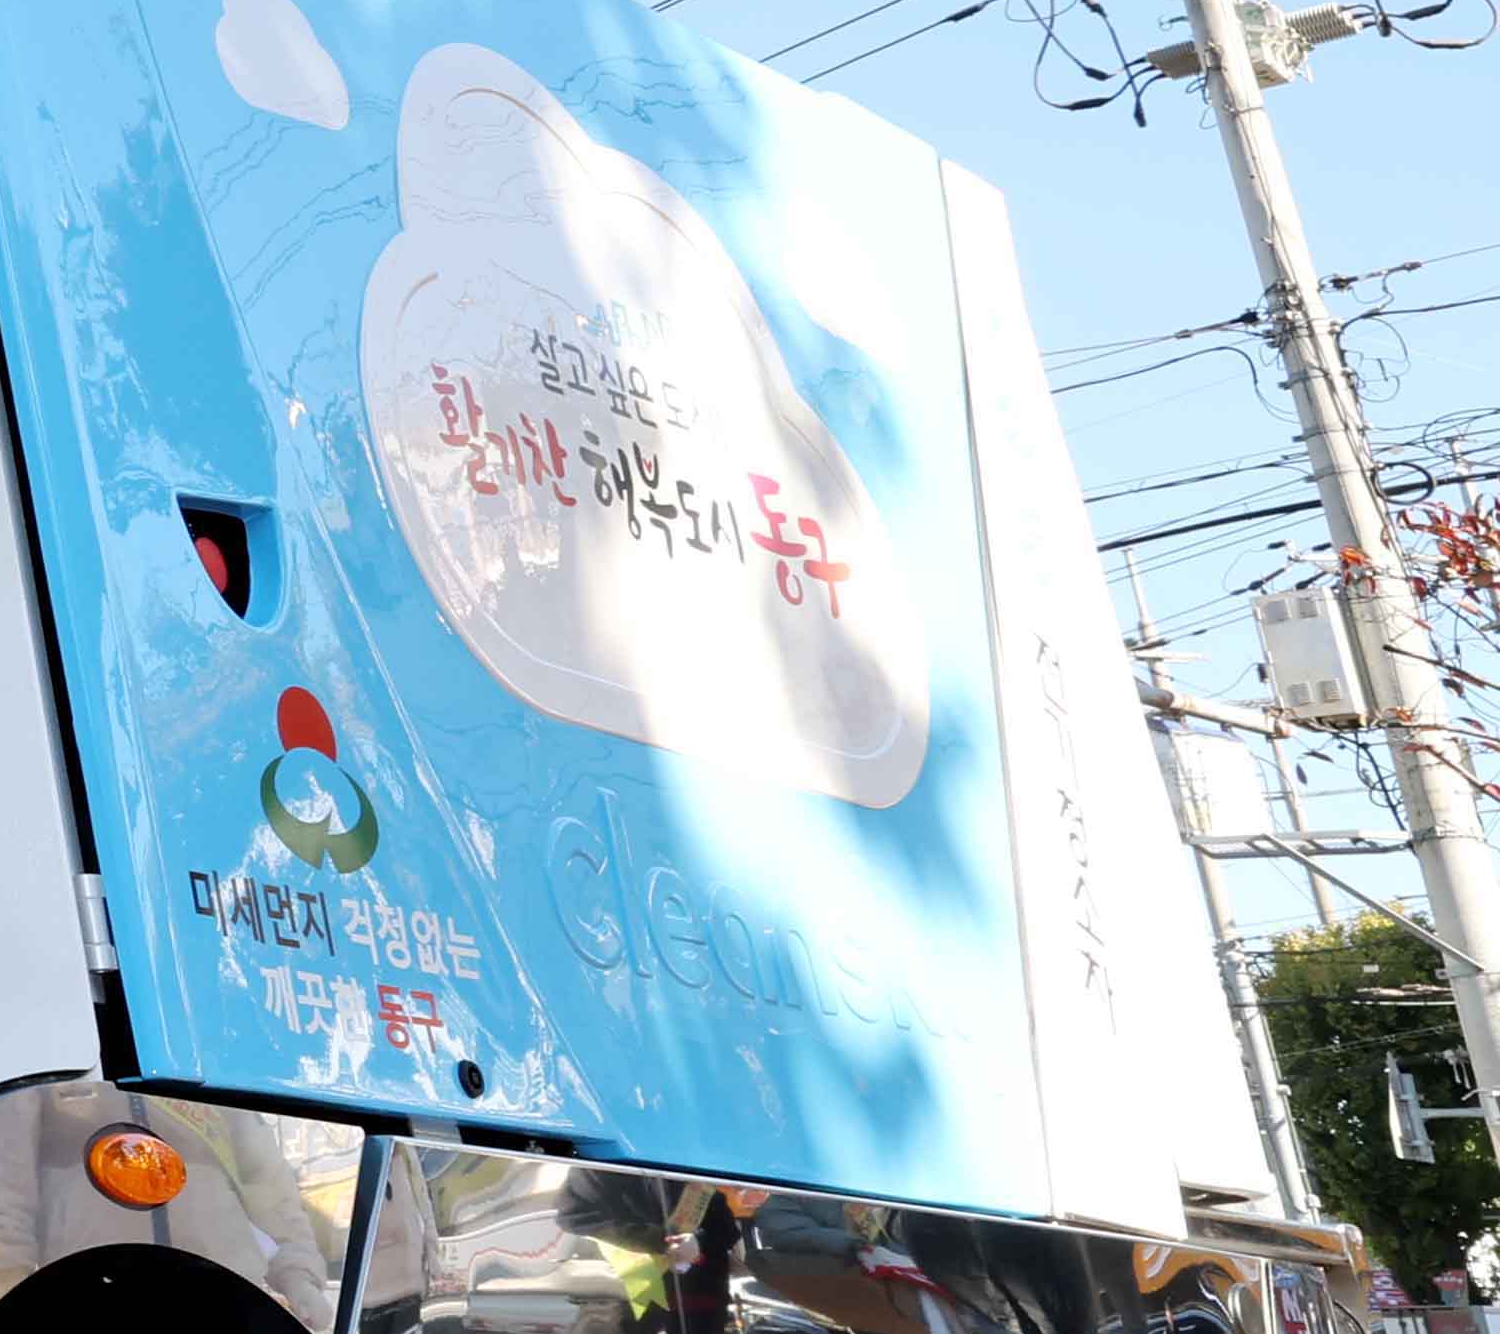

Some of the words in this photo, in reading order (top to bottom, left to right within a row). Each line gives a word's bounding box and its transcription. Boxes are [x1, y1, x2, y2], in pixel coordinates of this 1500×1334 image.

[530, 328, 597, 395] 살고
[598, 353, 658, 428] 싶은
[431, 362, 577, 507] 활기찬
[579, 429, 746, 564] 행복도시
[748, 472, 851, 619] 동구
[189, 870, 335, 957] 미세먼지
[341, 897, 482, 980] 걱정없는
[259, 965, 376, 1045] 깨끗한
[377, 984, 444, 1054] 동구
